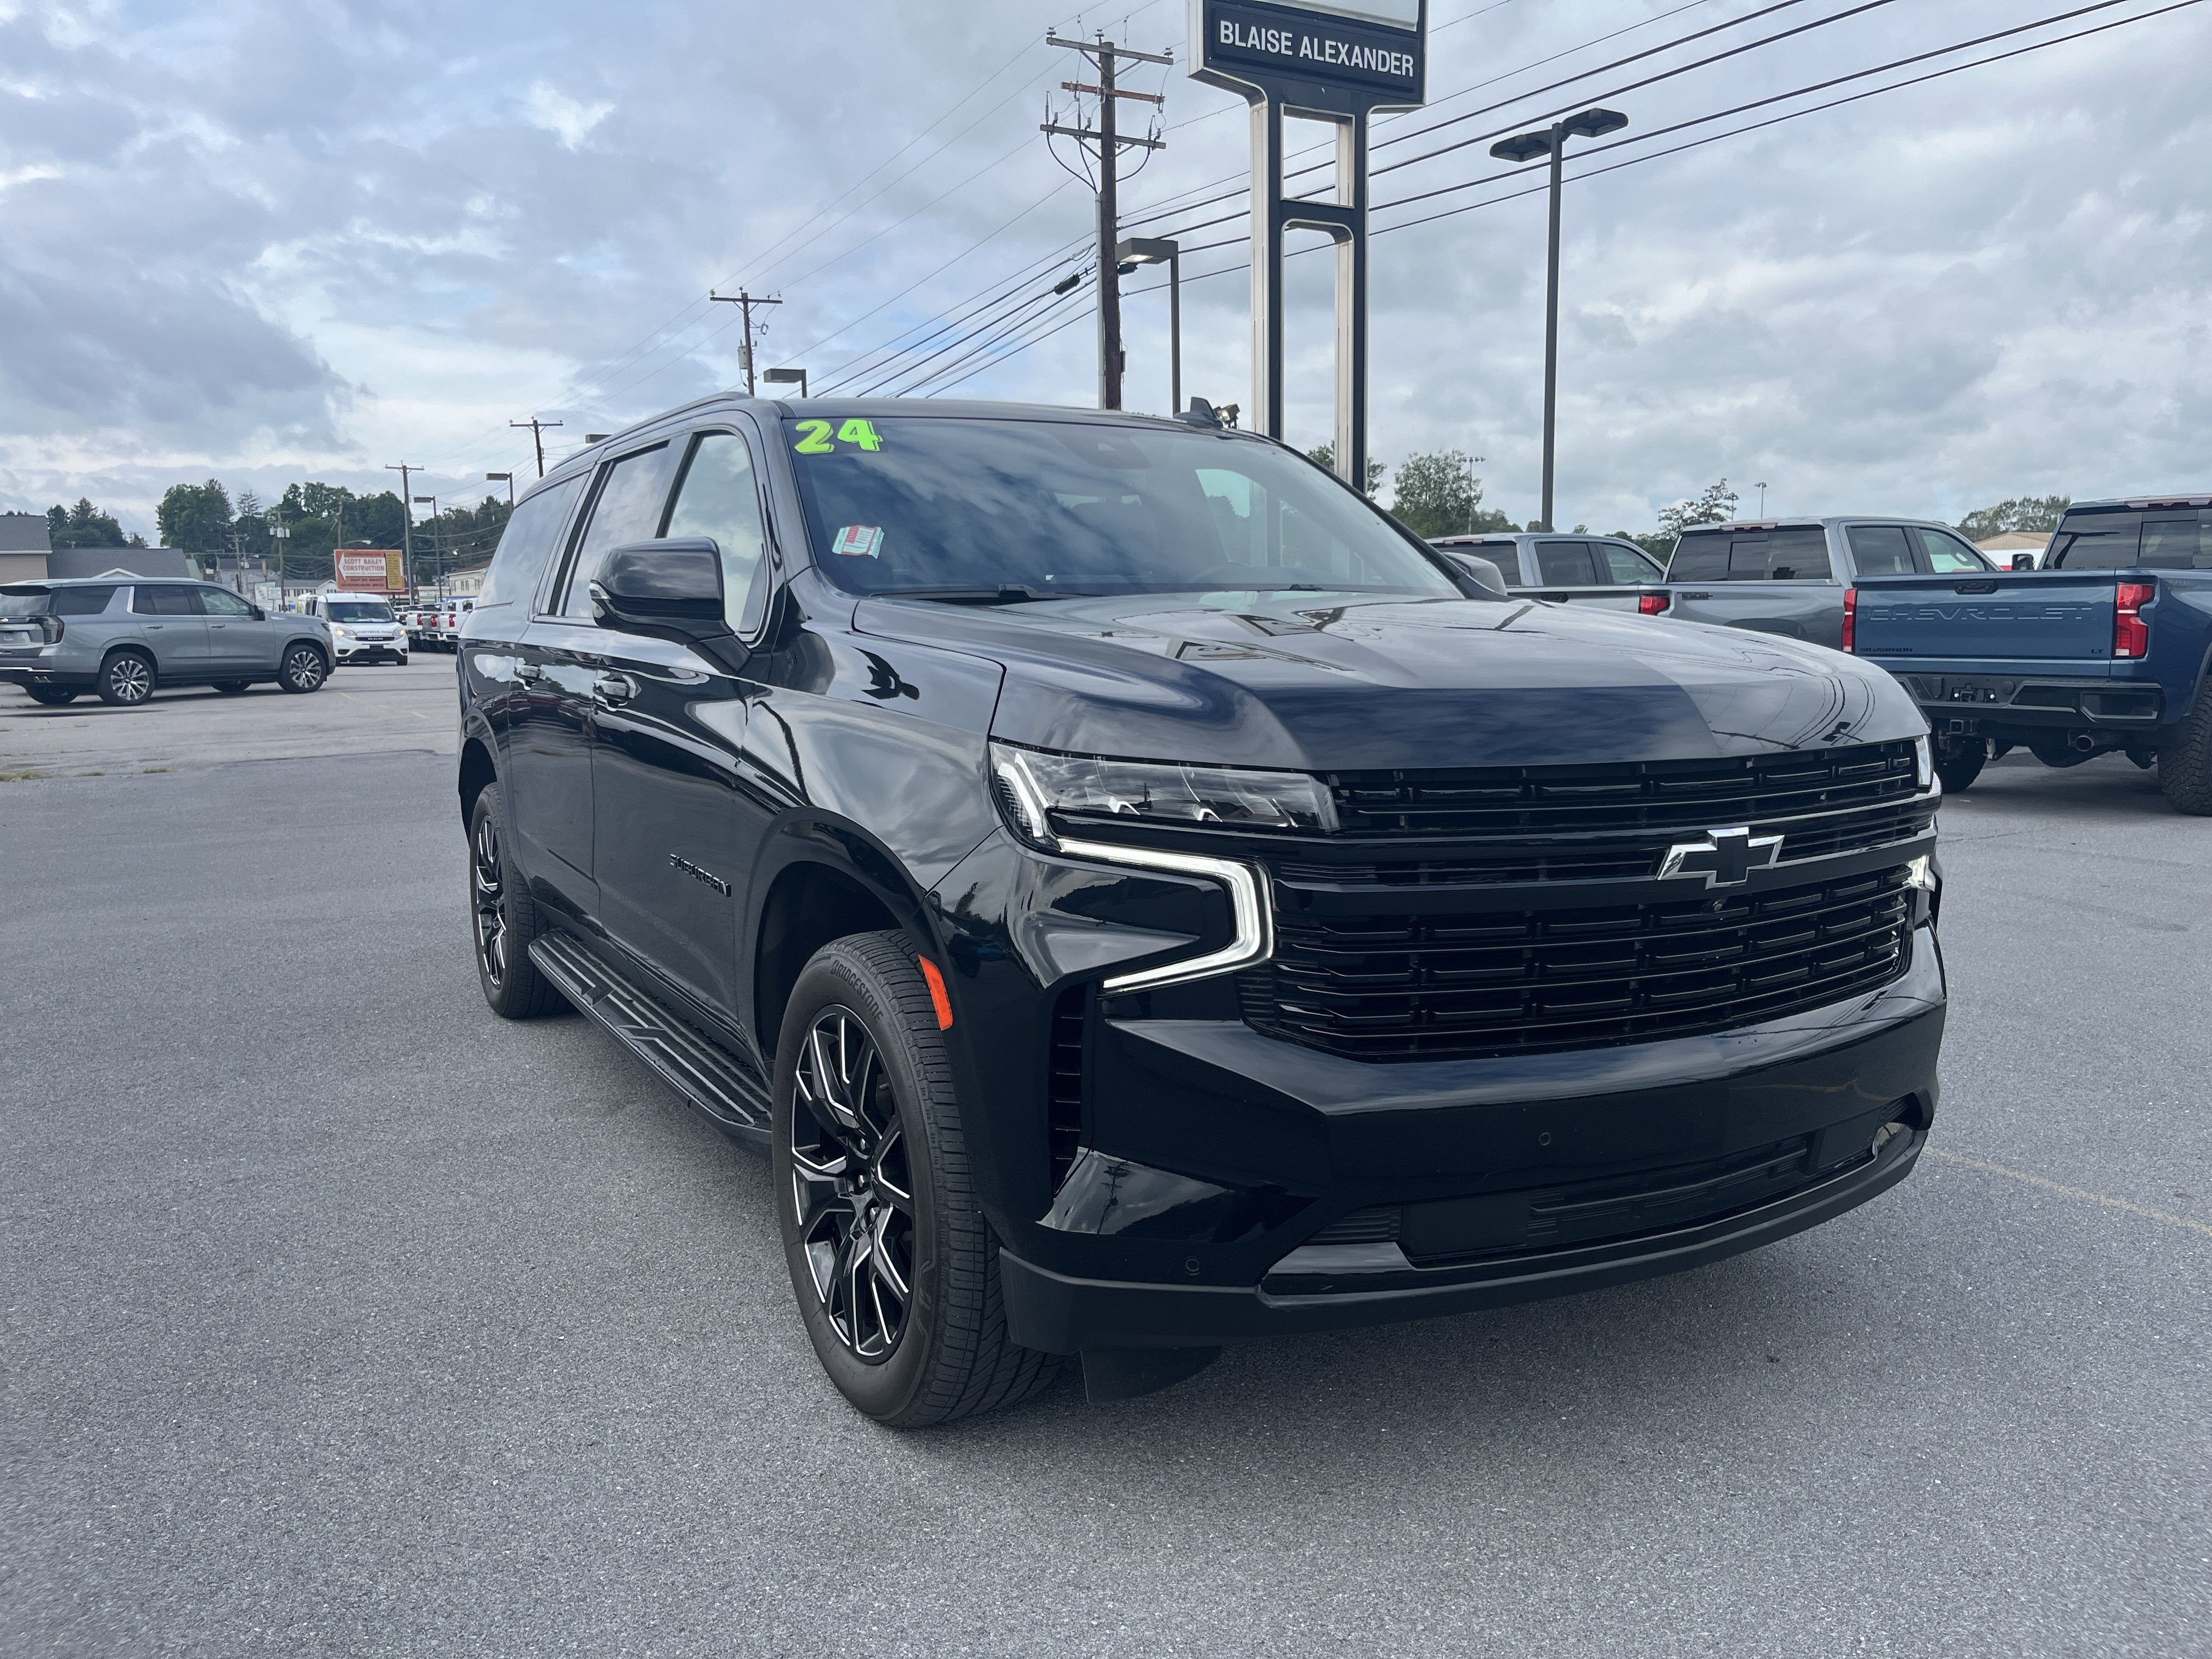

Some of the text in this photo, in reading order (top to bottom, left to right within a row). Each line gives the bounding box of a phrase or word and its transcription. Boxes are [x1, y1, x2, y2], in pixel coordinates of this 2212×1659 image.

[1220, 20, 1414, 77] BLAISE ALEXANDER
[794, 419, 883, 454] 24
[1869, 607, 2092, 620] CHEVROLET
[669, 853, 732, 898] SUBURBAN
[831, 959, 884, 1025] BRIDGESTONE
